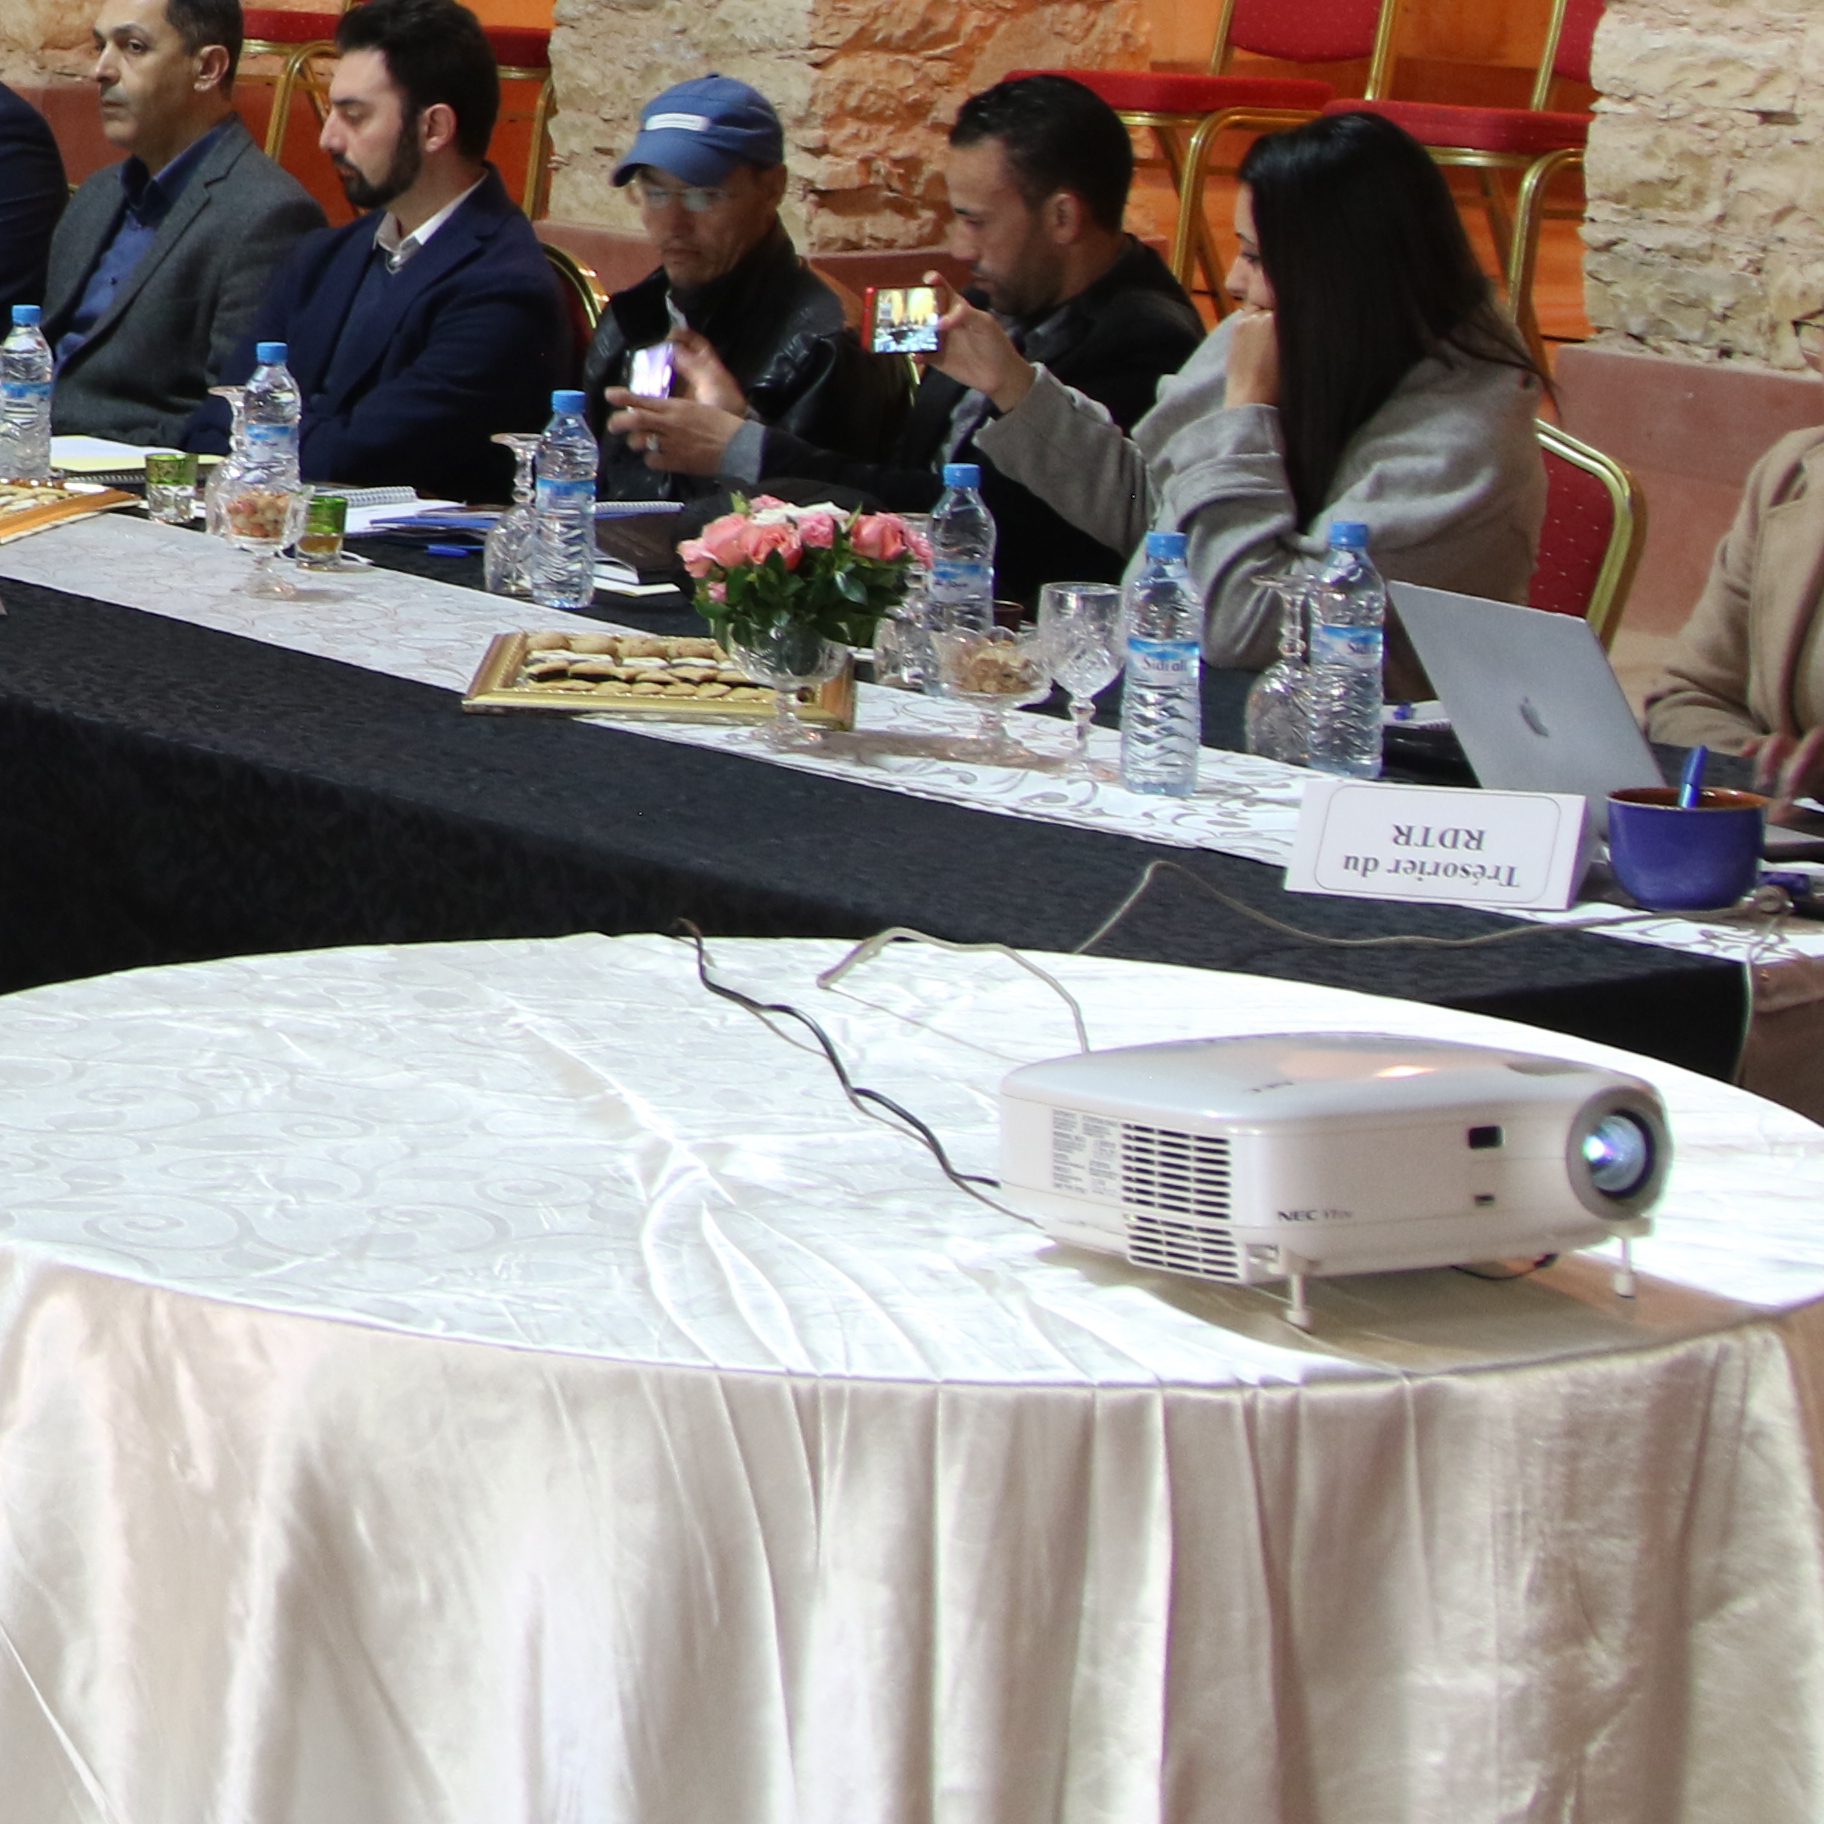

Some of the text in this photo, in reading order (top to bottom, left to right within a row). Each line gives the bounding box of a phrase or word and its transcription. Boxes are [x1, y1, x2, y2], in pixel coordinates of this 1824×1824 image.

[1392, 823, 1488, 851] RDTR
[1343, 854, 1521, 888] Trésorier du
[1277, 1209, 1318, 1222] NEC
